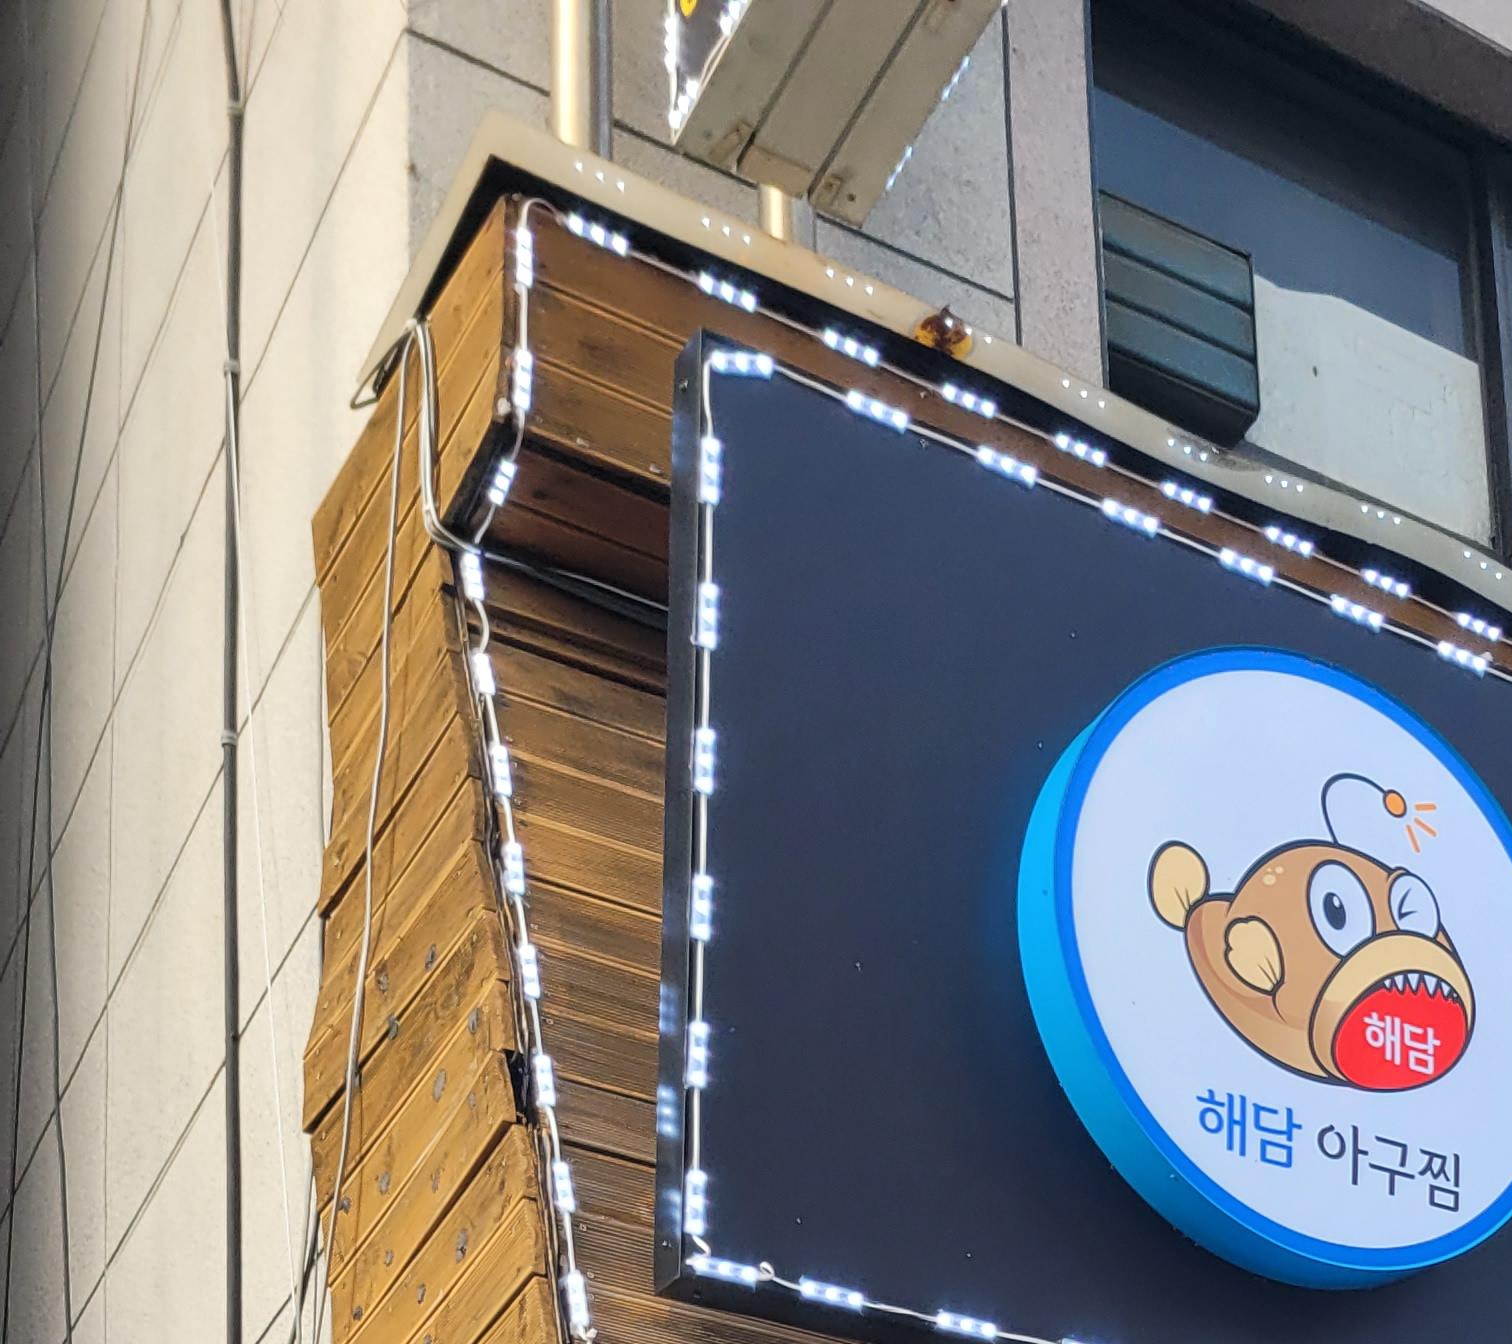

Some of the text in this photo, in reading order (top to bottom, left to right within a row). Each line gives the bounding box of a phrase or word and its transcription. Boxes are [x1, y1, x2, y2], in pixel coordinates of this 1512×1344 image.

[1363, 1011, 1440, 1074] 해담
[1196, 1089, 1461, 1212] 해담 아구찜
